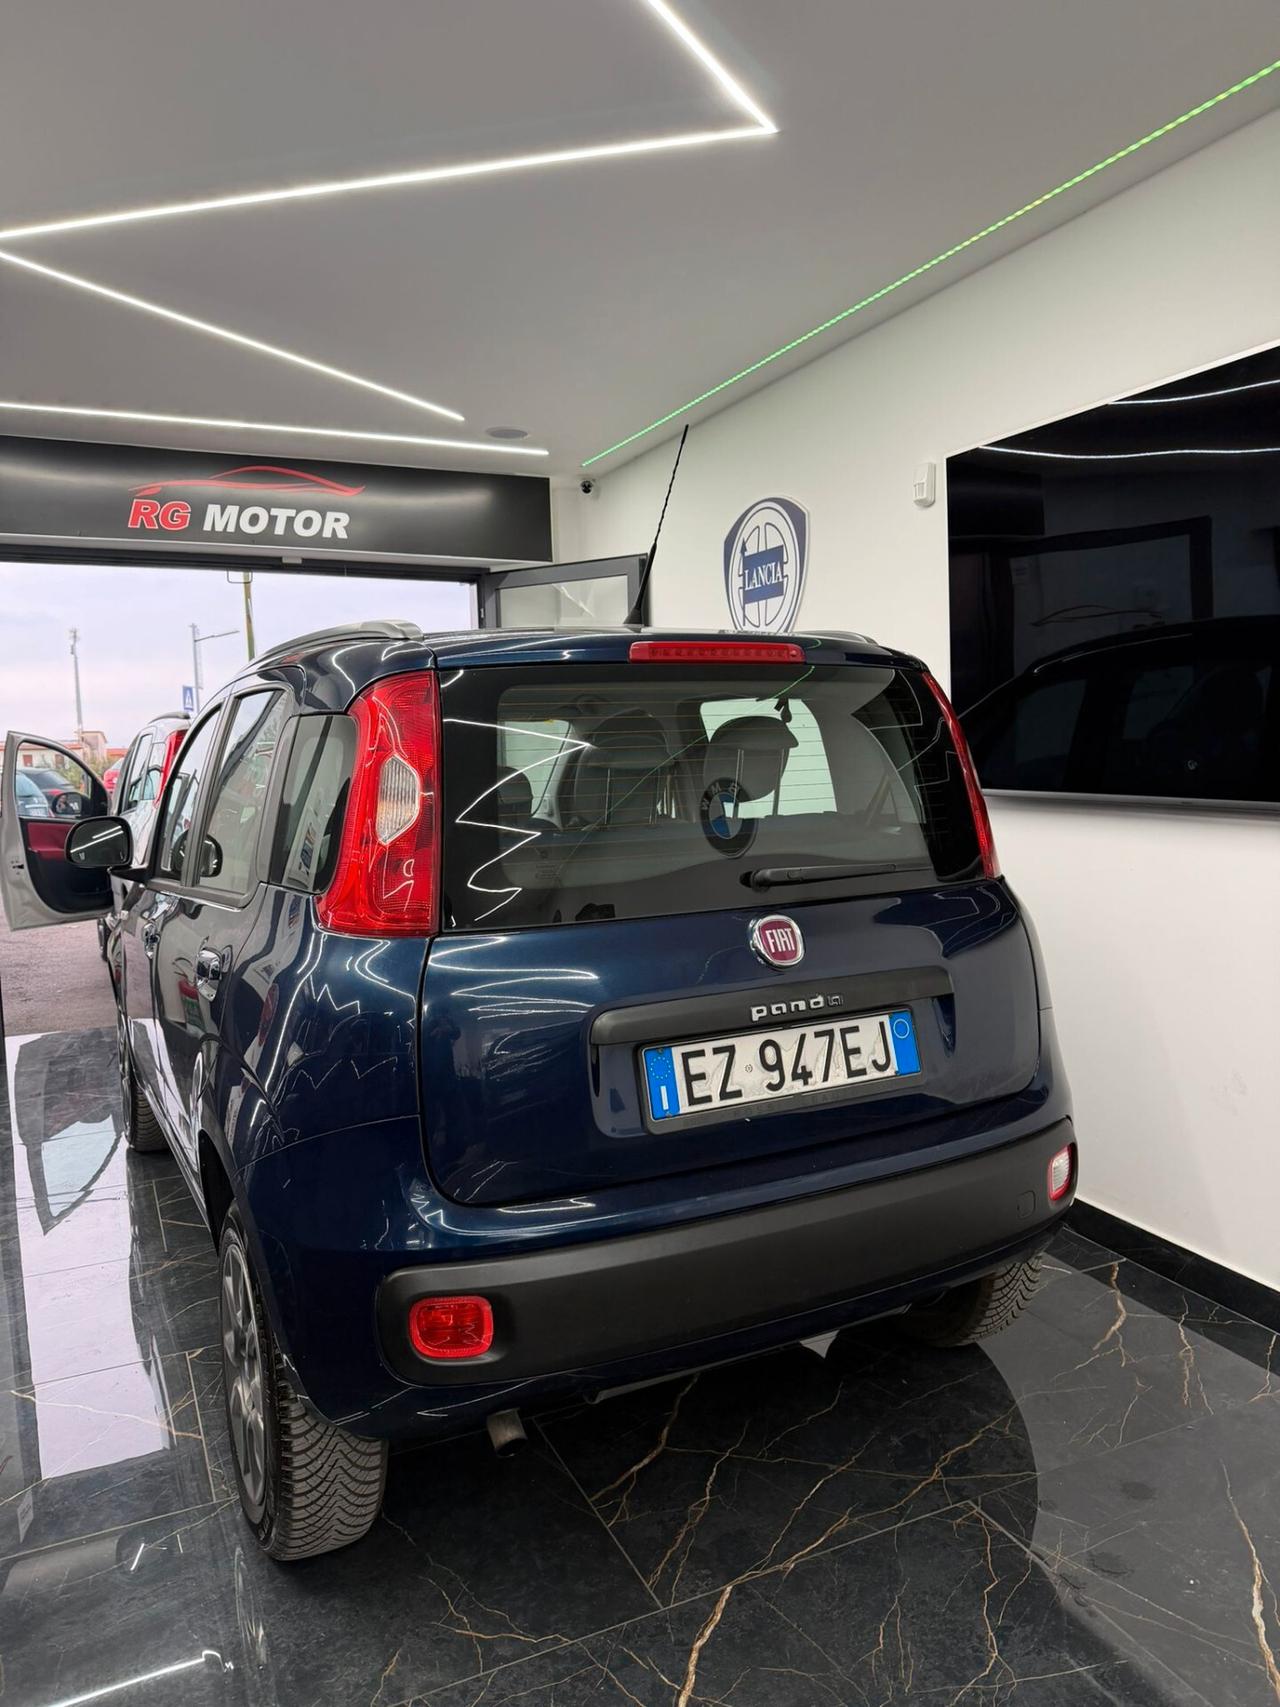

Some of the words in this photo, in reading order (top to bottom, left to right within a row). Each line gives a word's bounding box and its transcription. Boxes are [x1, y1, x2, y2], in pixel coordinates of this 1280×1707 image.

[128, 499, 191, 530] RG
[203, 504, 349, 538] MOTOR
[745, 561, 783, 591] LANCIA
[765, 927, 796, 953] FIAT
[681, 1044, 743, 1107] EZ
[758, 1021, 893, 1092] 947EJ
